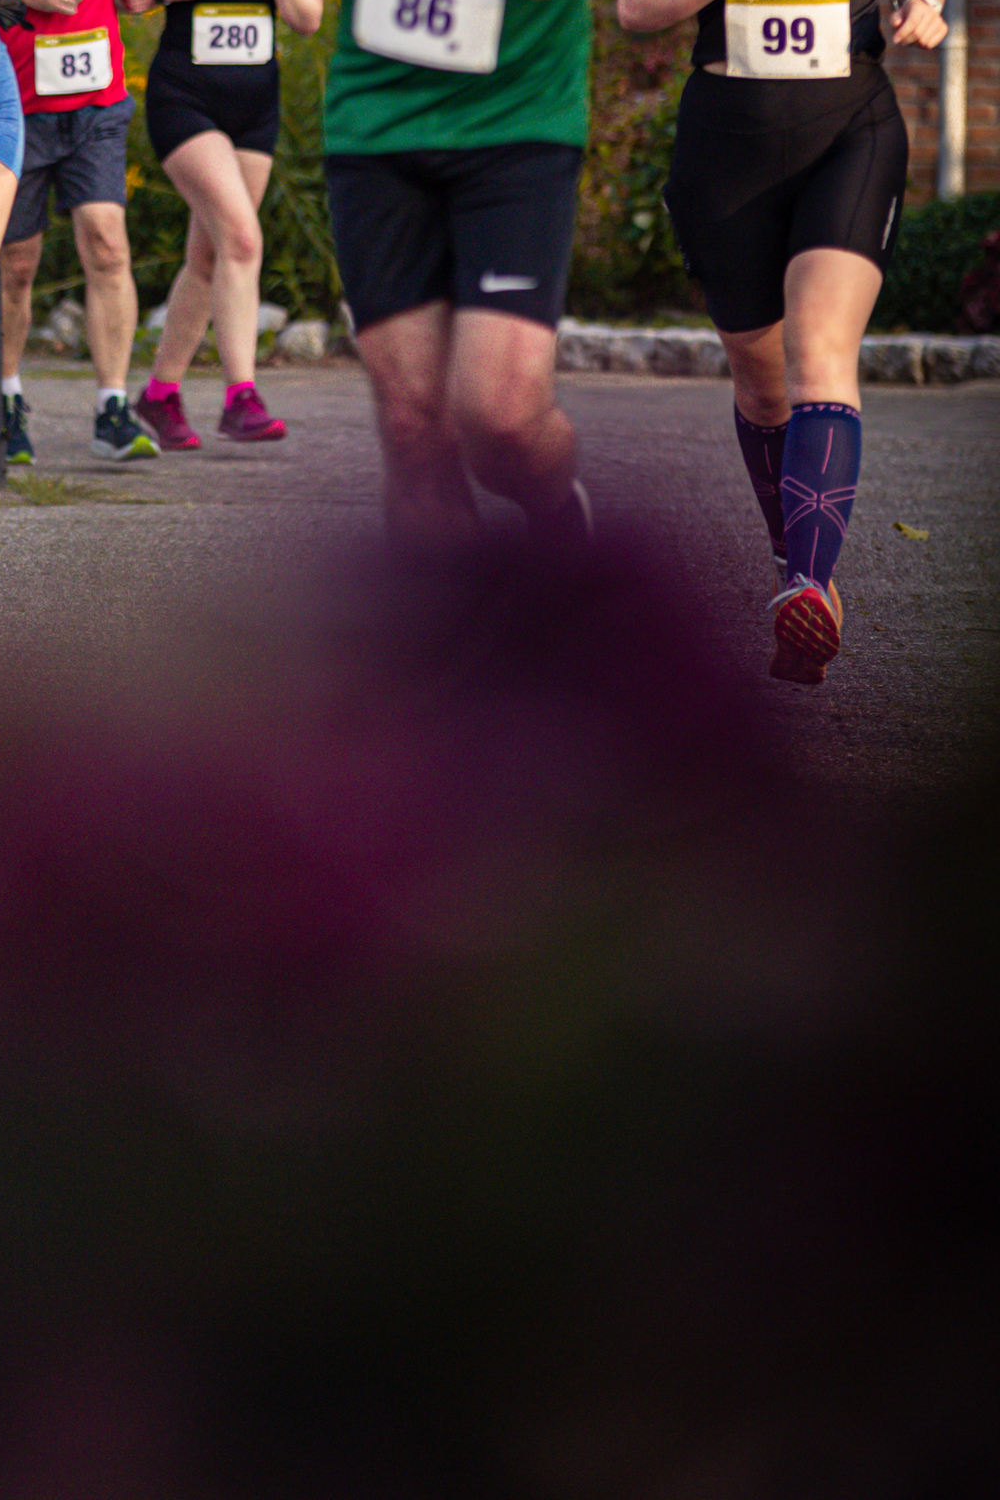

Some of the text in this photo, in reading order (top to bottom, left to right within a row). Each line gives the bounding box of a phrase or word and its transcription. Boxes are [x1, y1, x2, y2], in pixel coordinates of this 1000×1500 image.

[210, 25, 258, 49] 280
[762, 17, 815, 55] 99
[61, 52, 92, 77] 83
